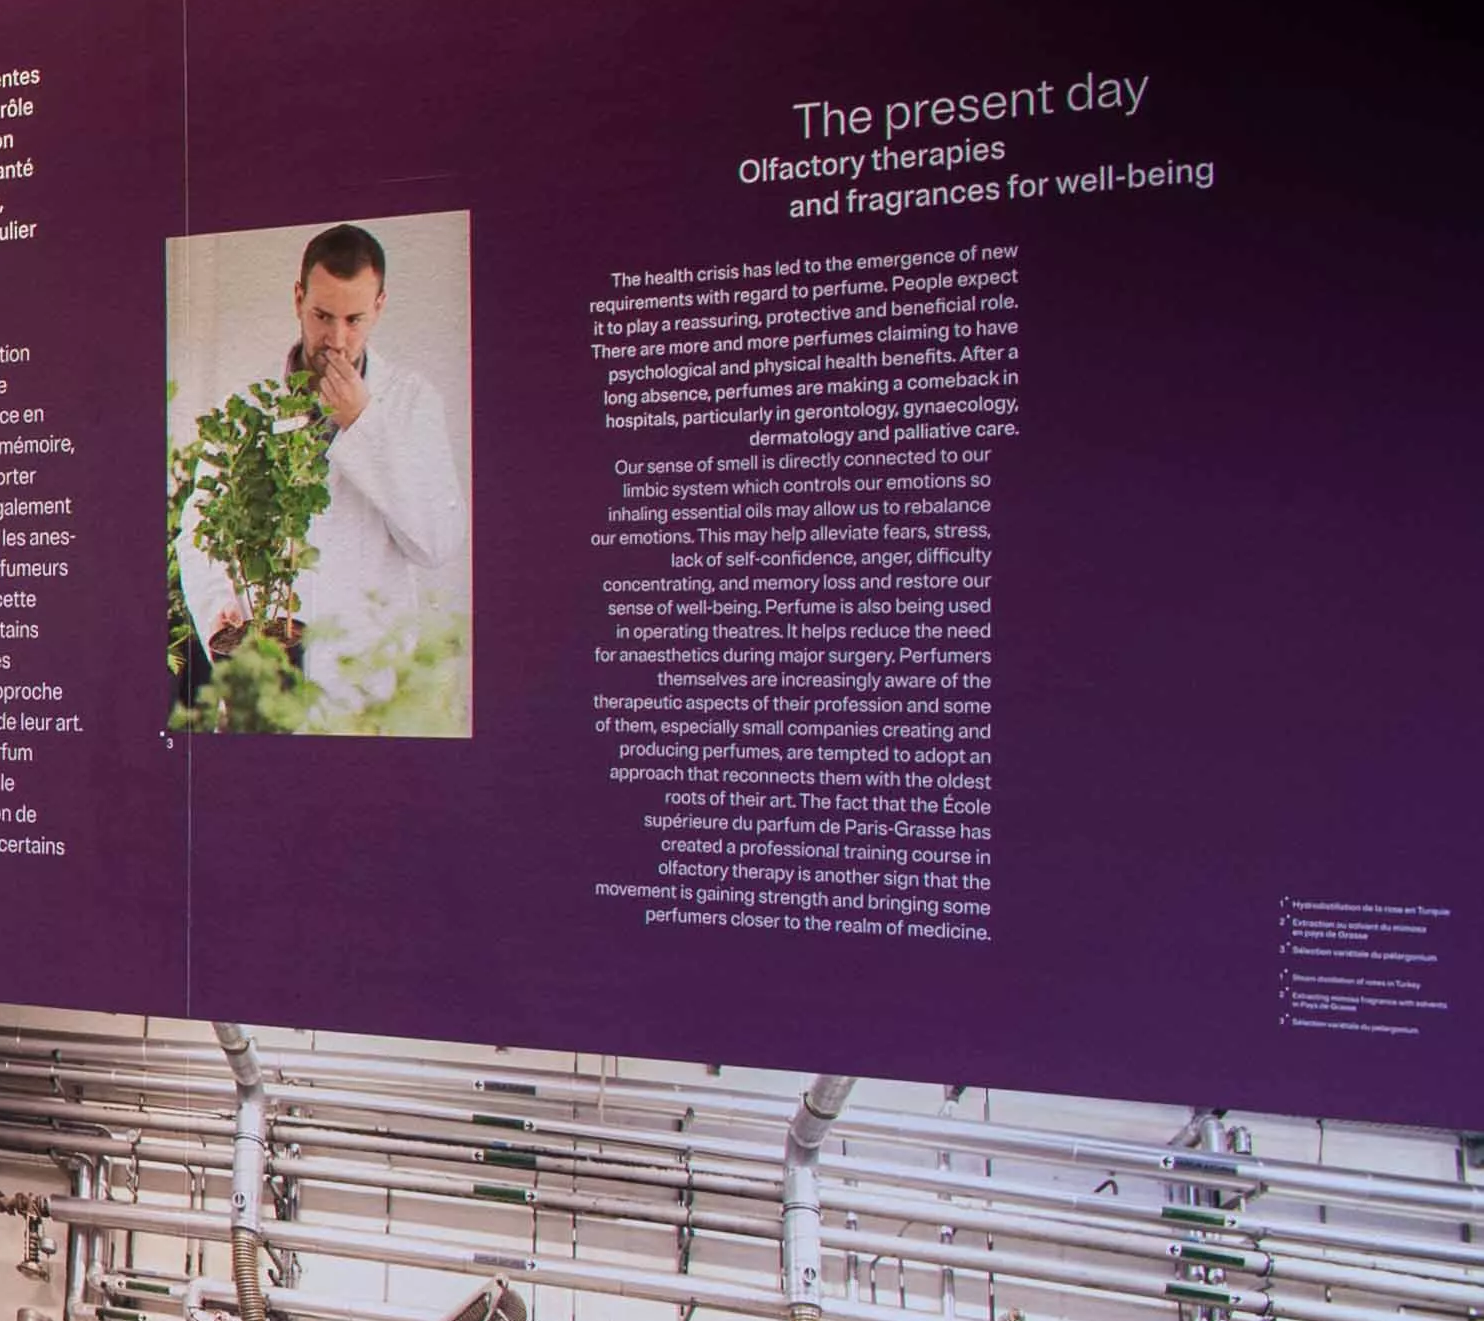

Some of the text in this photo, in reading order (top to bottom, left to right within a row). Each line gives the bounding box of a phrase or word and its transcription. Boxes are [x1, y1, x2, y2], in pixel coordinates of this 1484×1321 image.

[793, 72, 1149, 140] The present day
[739, 138, 1005, 184] Olfactory therapies
[790, 159, 1214, 218] and fragrances for well-being
[166, 737, 174, 749] 3
[645, 907, 991, 941] perfumers closer to the realm of medicine.
